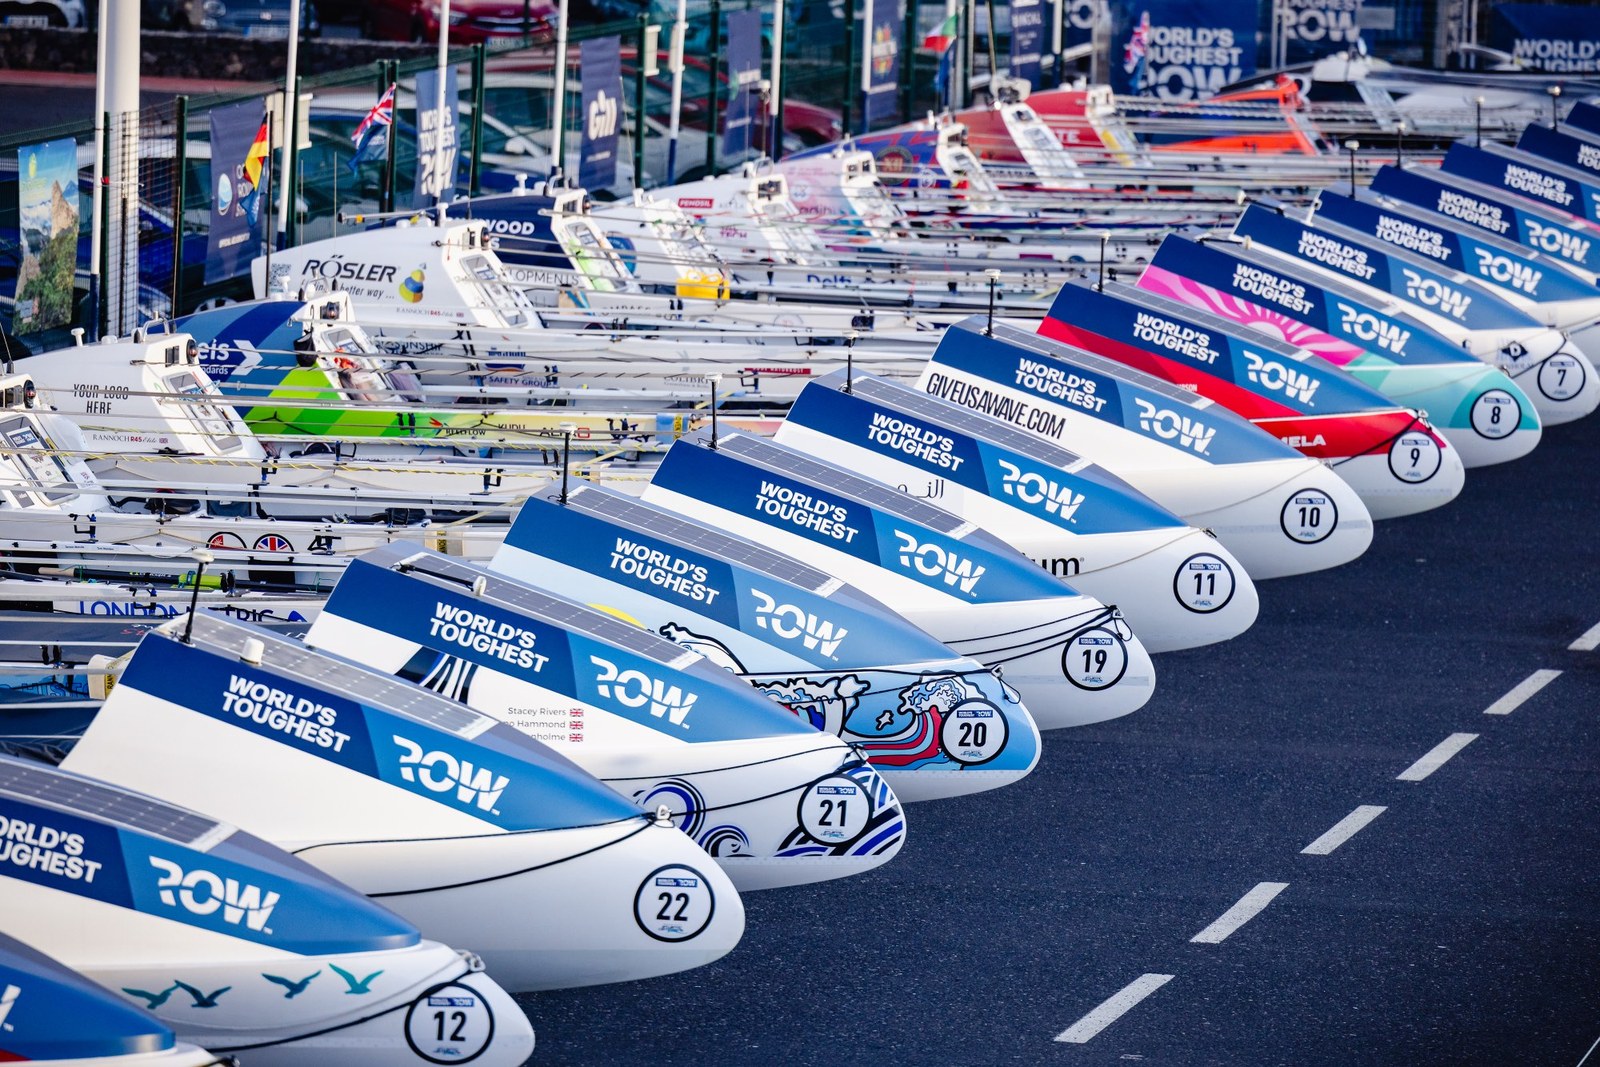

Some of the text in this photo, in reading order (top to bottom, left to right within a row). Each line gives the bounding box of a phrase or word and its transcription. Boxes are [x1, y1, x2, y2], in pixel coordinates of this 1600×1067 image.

[1504, 172, 1574, 206] TOUGHEST
[1506, 163, 1566, 193] WORLD'S
[1437, 199, 1510, 234] TOUGHEST
[1440, 190, 1502, 221] WORLD'S
[1301, 231, 1368, 265] WORLD'S
[1375, 224, 1451, 261] TOUGHEST
[1378, 215, 1443, 247] WORLD'S
[1524, 219, 1591, 264] ROW
[302, 254, 397, 283] RÖSLER
[1298, 240, 1376, 281] TOUGHEST
[1475, 248, 1542, 295] ROW
[367, 288, 385, 300] way
[1232, 273, 1314, 315] TOUGHEST
[1236, 264, 1306, 299] WORLD'S
[1402, 268, 1472, 320] ROW
[1132, 322, 1220, 365] TOUGHEST
[1136, 312, 1210, 348] WORLD'S
[1337, 302, 1411, 356] ROW
[198, 338, 230, 361] eis
[73, 383, 130, 400] YOUR LOGO
[489, 376, 521, 385] SAFETY
[1015, 370, 1107, 413] TOUGHEST
[1019, 358, 1097, 394] WORLD'S
[1243, 350, 1320, 407] ROW
[1558, 368, 1567, 387] 7
[86, 400, 112, 415] HERE
[926, 373, 1067, 440] GIVEUSAWAVE.COM
[1491, 406, 1501, 424] 8
[93, 434, 129, 442] RANNOCH
[872, 412, 954, 453] WORLD'S
[1135, 397, 1216, 456] ROW
[868, 425, 964, 472] TOUGHEST
[1411, 448, 1420, 468] 9
[760, 480, 848, 522] WORLD'S
[999, 459, 1086, 523] ROW
[755, 495, 858, 543] TOUGHEST
[1299, 507, 1321, 528] 10
[615, 537, 708, 583] WORLD'S
[894, 529, 986, 597] ROW
[610, 553, 720, 606] TOUGHEST
[1194, 573, 1215, 596] 11
[435, 602, 537, 649] WORLD'S
[751, 588, 848, 661] ROW
[429, 617, 549, 673] TOUGHEST
[1082, 649, 1107, 673] 19
[228, 674, 338, 727] WORLD'S
[590, 655, 698, 729] ROW
[222, 691, 350, 752] TOUGHEST
[508, 707, 566, 716] Stacey Rivers
[517, 720, 566, 728] Hammond
[958, 722, 987, 747] 20
[392, 735, 510, 815] ROW
[818, 799, 847, 827] 21
[0, 838, 102, 884] UGHEST
[149, 855, 280, 935] ROW
[656, 892, 690, 922] 22
[434, 1011, 466, 1042] 12
